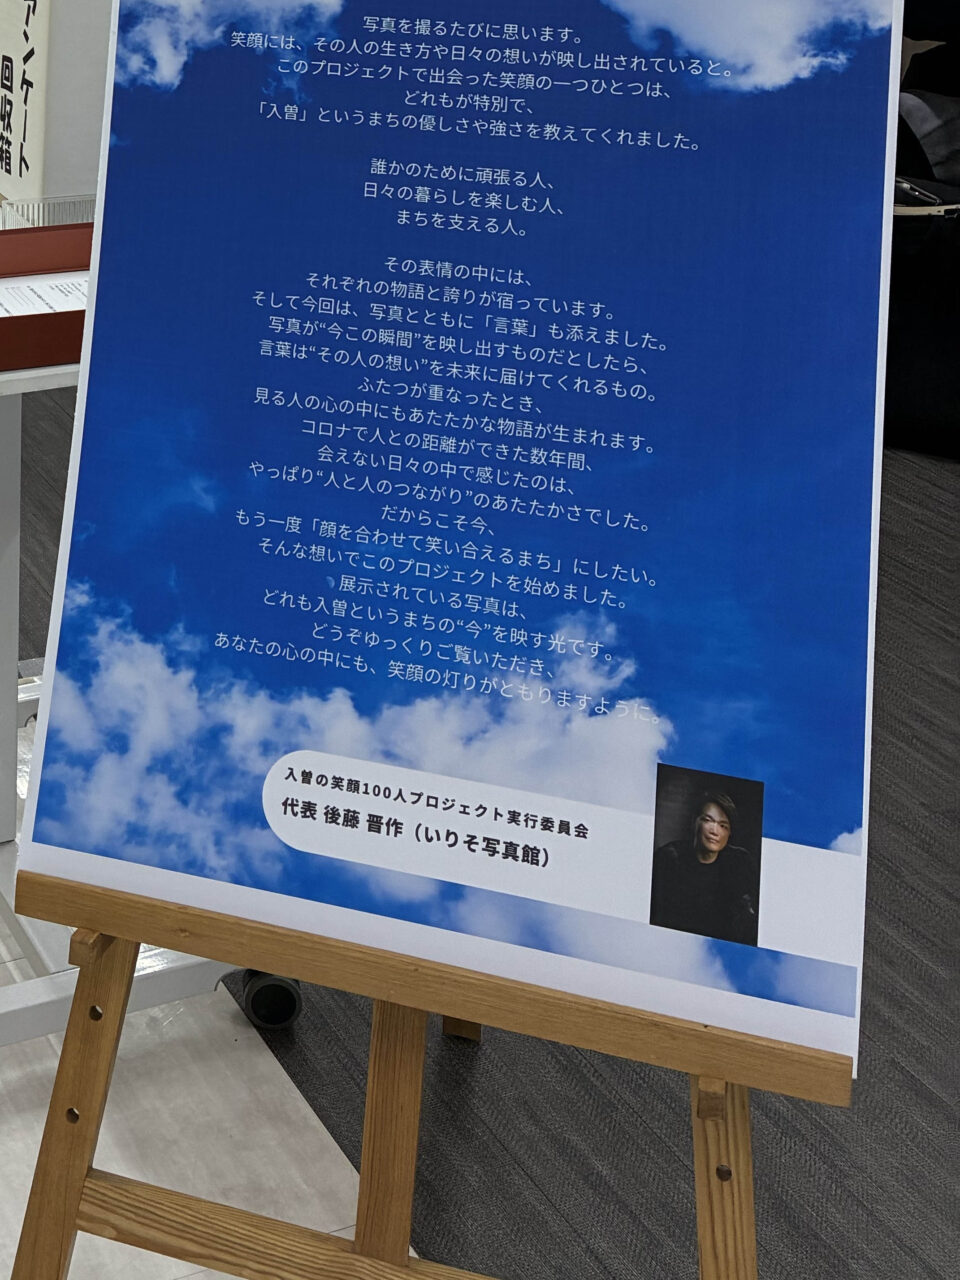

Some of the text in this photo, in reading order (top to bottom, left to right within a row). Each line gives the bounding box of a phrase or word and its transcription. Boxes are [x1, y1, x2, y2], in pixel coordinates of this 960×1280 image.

[362, 16, 582, 44] 写真を撮るたびに思います。
[230, 31, 732, 77] 笑顔には、その人の生き方や日々の想いが映し出されていると。
[277, 59, 672, 99] このプロジェクトで出会った笑顔の一つひとつは、
[404, 90, 534, 114] どれもが特別で、
[258, 101, 700, 151] 「入曽」というまちの優しさや強さを教えてくれました。
[370, 157, 554, 189] 誰かのために頑張る人、
[363, 181, 564, 215] 日々の暮らしを楽しむ人、
[396, 209, 526, 237] まちを支える人。
[384, 256, 532, 287] その表情の中には、
[306, 272, 614, 320] それぞれの物語と誇りが宿っています。
[252, 290, 667, 352] そして今回は、写真とともに「言葉」も添えました。
[357, 376, 543, 414] ふたつが重なったとき、
[253, 386, 654, 454] 見る人の心の中にもあたたかな物語が生まれます。
[301, 419, 592, 472] コロナで人との距離ができた数年間、
[317, 444, 575, 495] 会えない日々の中で感じたのは、
[380, 504, 495, 536] だからこそ今、
[235, 508, 657, 588] もう一度「顔を合わせて笑い合えるまち」にしたい。
[258, 537, 626, 609] そんな想いでこのプロジェクトを始めました。
[338, 574, 527, 620] 展示されている写真は、
[311, 622, 554, 679] どうぞゆっくりご覧いただき、
[214, 631, 660, 725] あなたの心の中にも、笑顔の灯りがともりますように。
[281, 796, 318, 821] 代表
[323, 803, 361, 830] 後藤
[284, 766, 590, 840] 入曽の笑顔100人プロジェクト実行委員会
